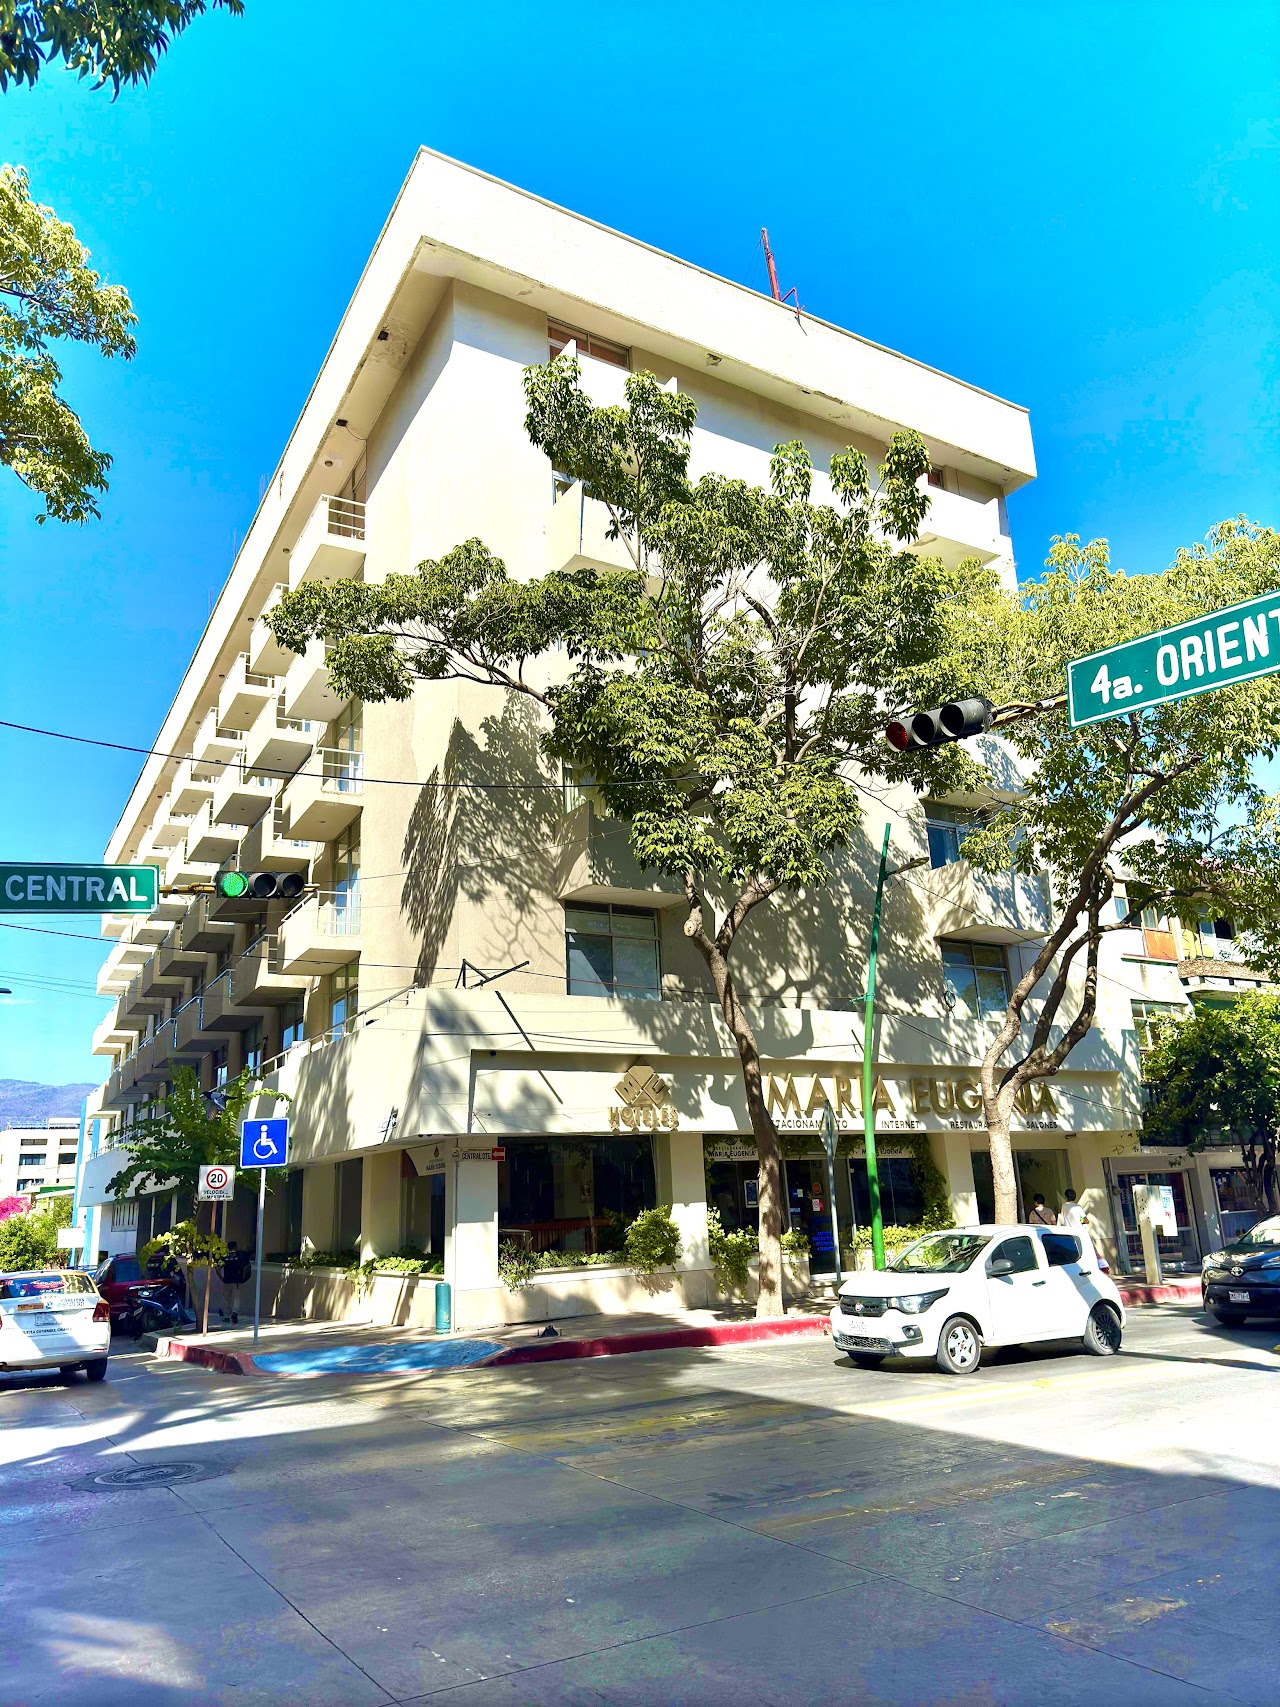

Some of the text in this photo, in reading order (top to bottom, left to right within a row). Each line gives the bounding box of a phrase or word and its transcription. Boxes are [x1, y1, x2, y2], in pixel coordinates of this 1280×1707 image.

[1091, 664, 1143, 704] 4a.
[5, 875, 148, 902] CENTRAL
[767, 1072, 897, 1116] MARIA
[608, 1106, 679, 1127] HOTELES
[881, 1120, 920, 1129] INTERNET
[1026, 1121, 1058, 1129] SALONES
[210, 1173, 223, 1183] 20
